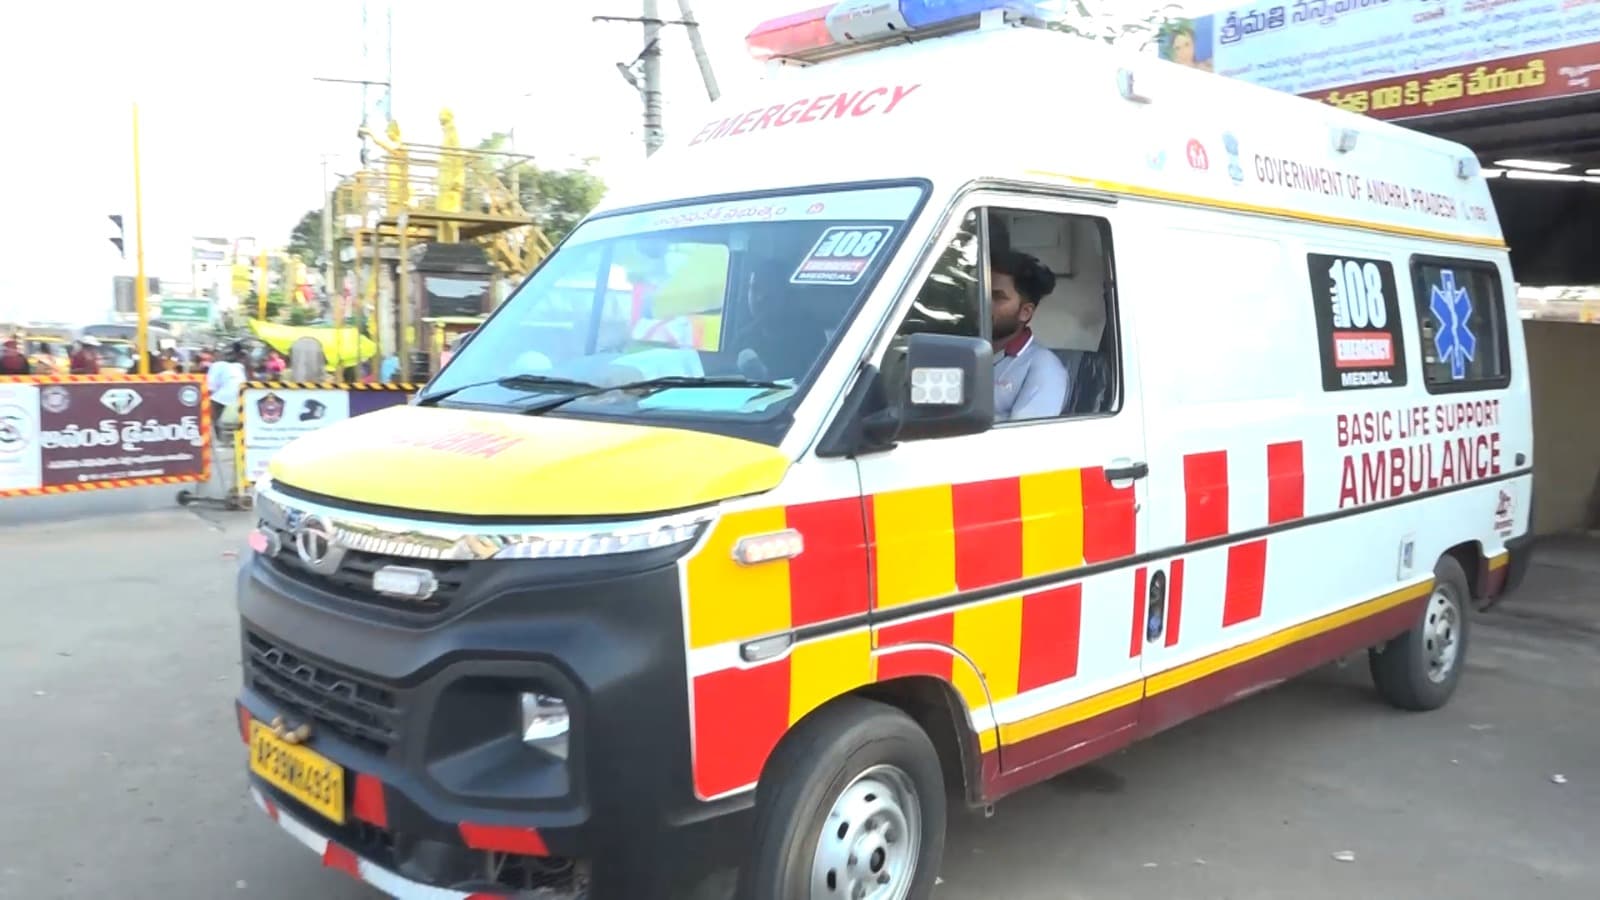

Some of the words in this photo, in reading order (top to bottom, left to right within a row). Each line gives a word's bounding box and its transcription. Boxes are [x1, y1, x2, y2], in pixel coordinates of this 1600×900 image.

[688, 84, 921, 147] EMERGENCY
[1371, 86, 1402, 109] 108
[1254, 154, 1344, 197] GOVERNMENT
[1347, 174, 1361, 200] OF
[1365, 178, 1410, 208] ANDHRA
[1411, 188, 1457, 219] PRADESH
[820, 230, 882, 257] 108
[1329, 259, 1387, 328] 108
[1341, 371, 1393, 387] MEDICAL
[1337, 410, 1393, 447] BASIC
[1398, 406, 1430, 439] LIFE
[1435, 400, 1500, 433] SUPPORT
[1338, 432, 1501, 509] AMBULANCE
